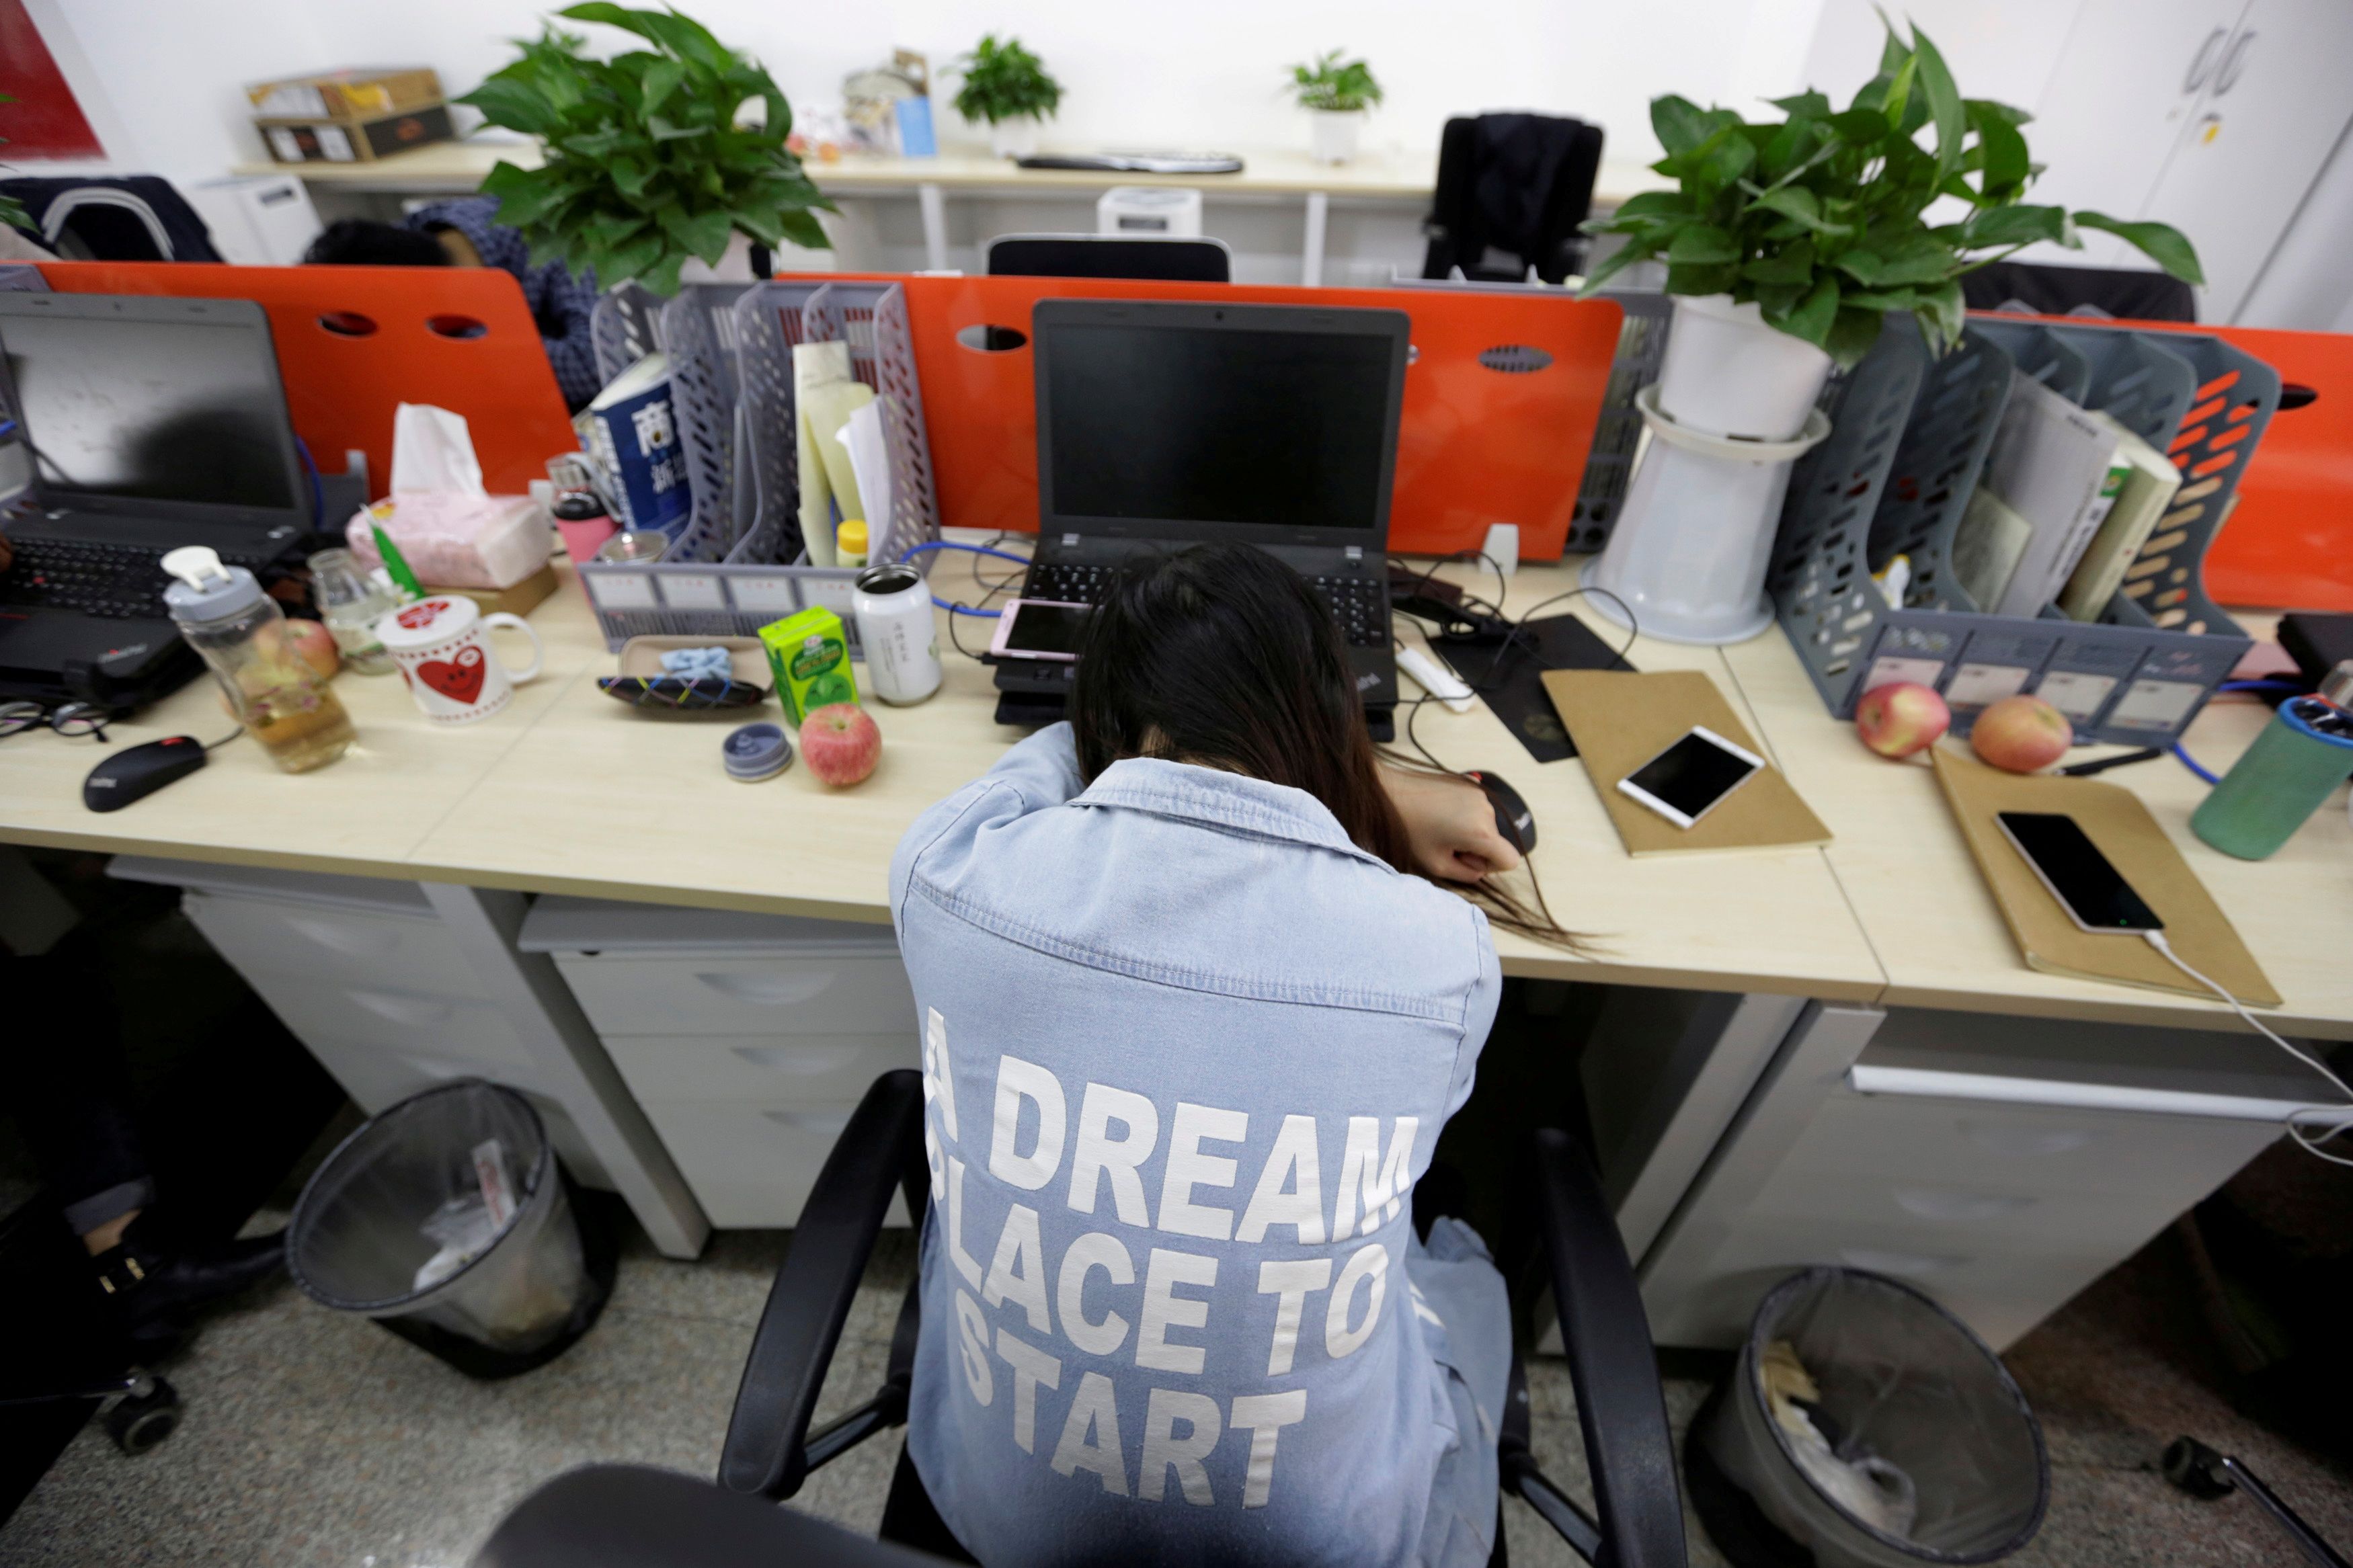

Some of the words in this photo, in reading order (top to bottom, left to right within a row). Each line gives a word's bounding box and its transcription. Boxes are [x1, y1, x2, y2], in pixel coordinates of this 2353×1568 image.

[923, 1005, 959, 1143] A
[988, 1055, 1420, 1245] DREAM
[955, 1287, 1308, 1510] START
[1256, 1243, 1390, 1377] TO
